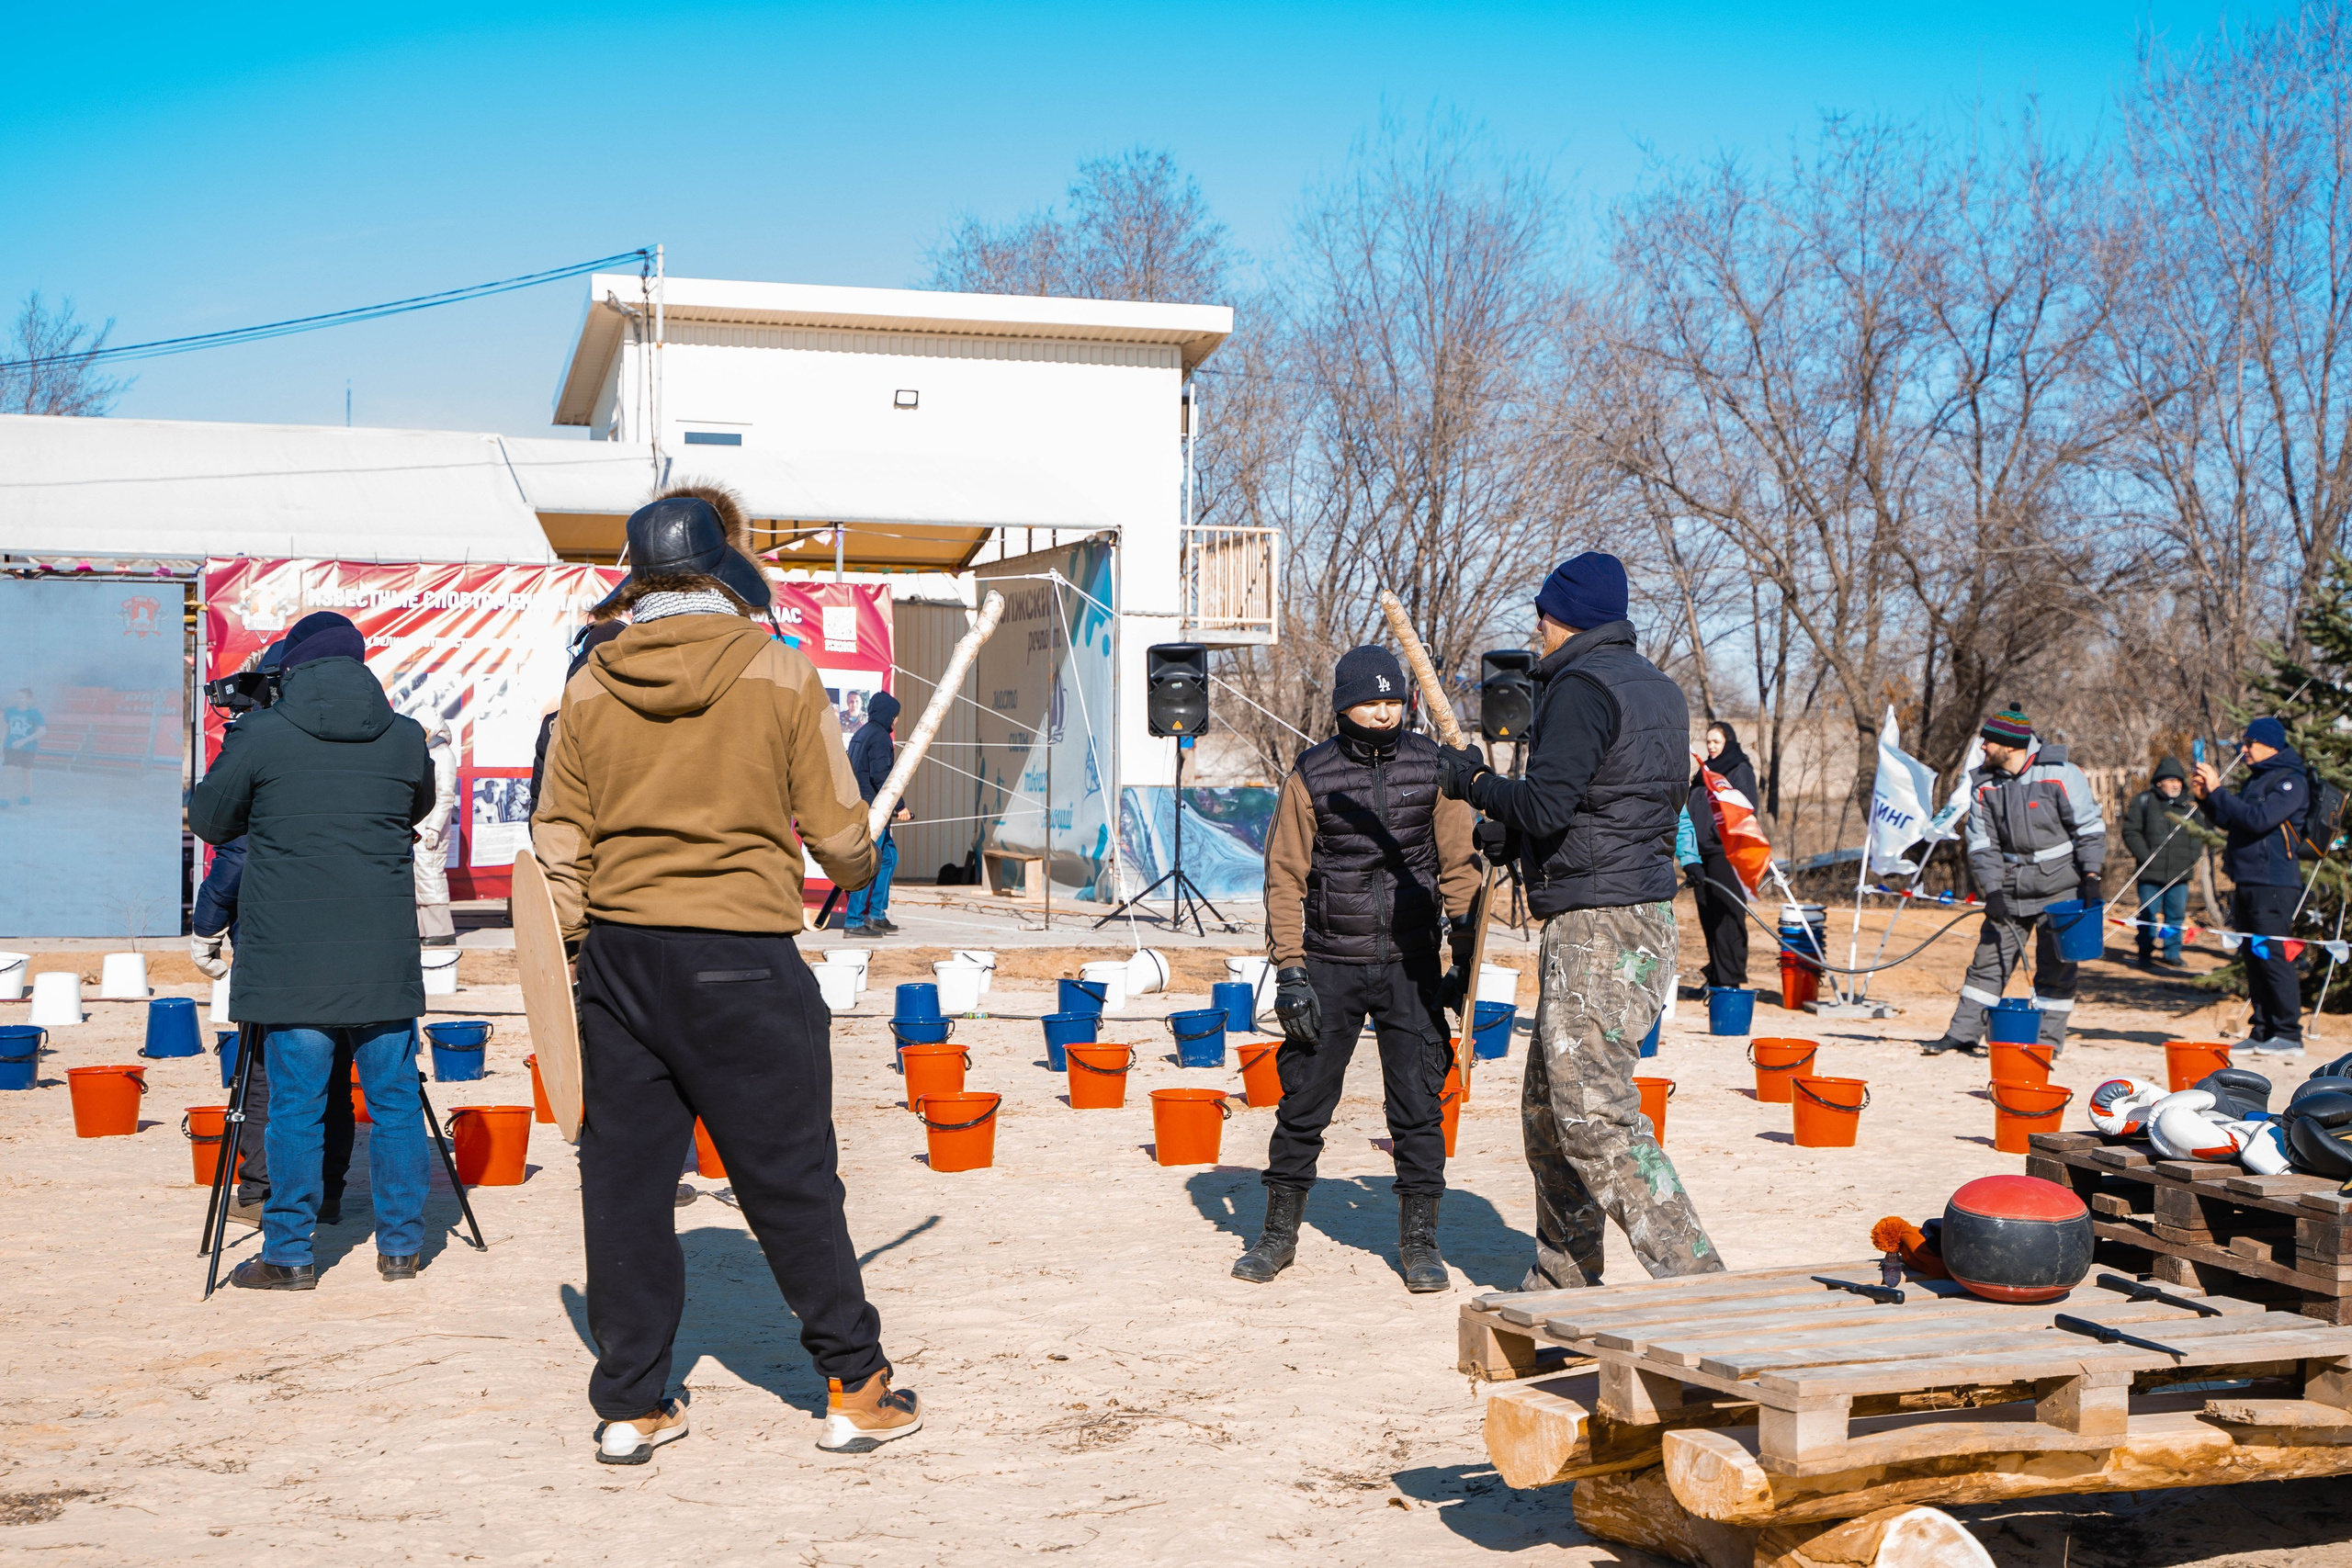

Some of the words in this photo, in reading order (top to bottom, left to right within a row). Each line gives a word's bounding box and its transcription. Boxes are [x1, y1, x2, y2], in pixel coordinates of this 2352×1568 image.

[308, 588, 419, 608] ИЗВЕСТНЫЕ
[423, 591, 548, 613] СПОРТСМЕН
[1000, 586, 1060, 624] ОЛЖСКИ
[1026, 627, 1061, 666] речпот
[1375, 674, 1391, 693] LA
